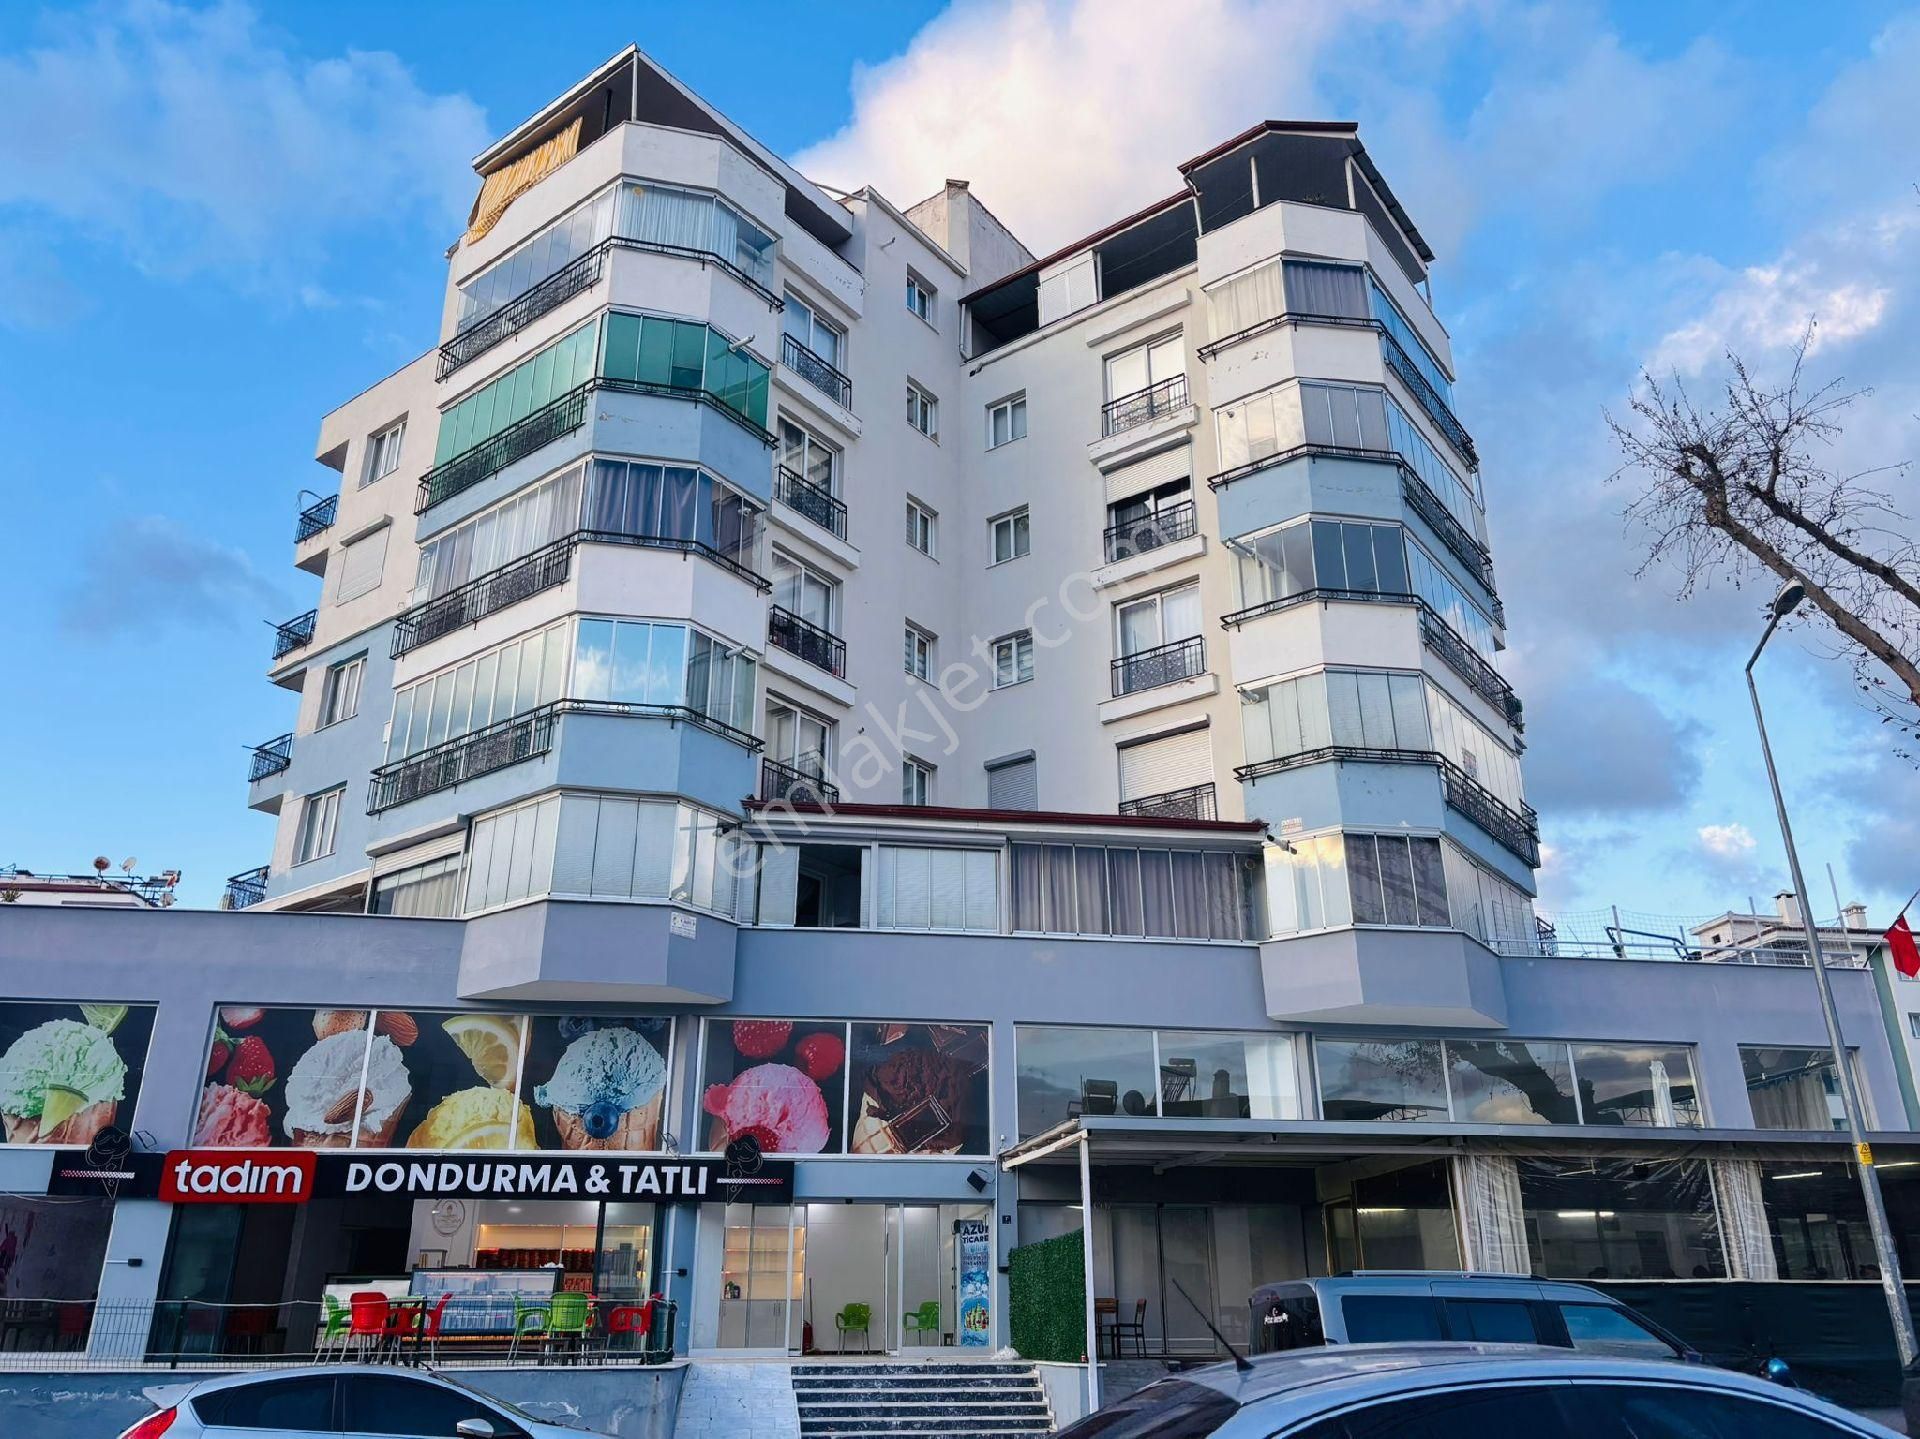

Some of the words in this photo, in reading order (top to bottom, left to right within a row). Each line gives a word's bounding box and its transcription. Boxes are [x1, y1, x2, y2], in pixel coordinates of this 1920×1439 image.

[174, 1159, 303, 1194] tadım
[345, 1162, 578, 1194] DONDURMA
[584, 1164, 611, 1194] &
[618, 1165, 708, 1195] TATLI
